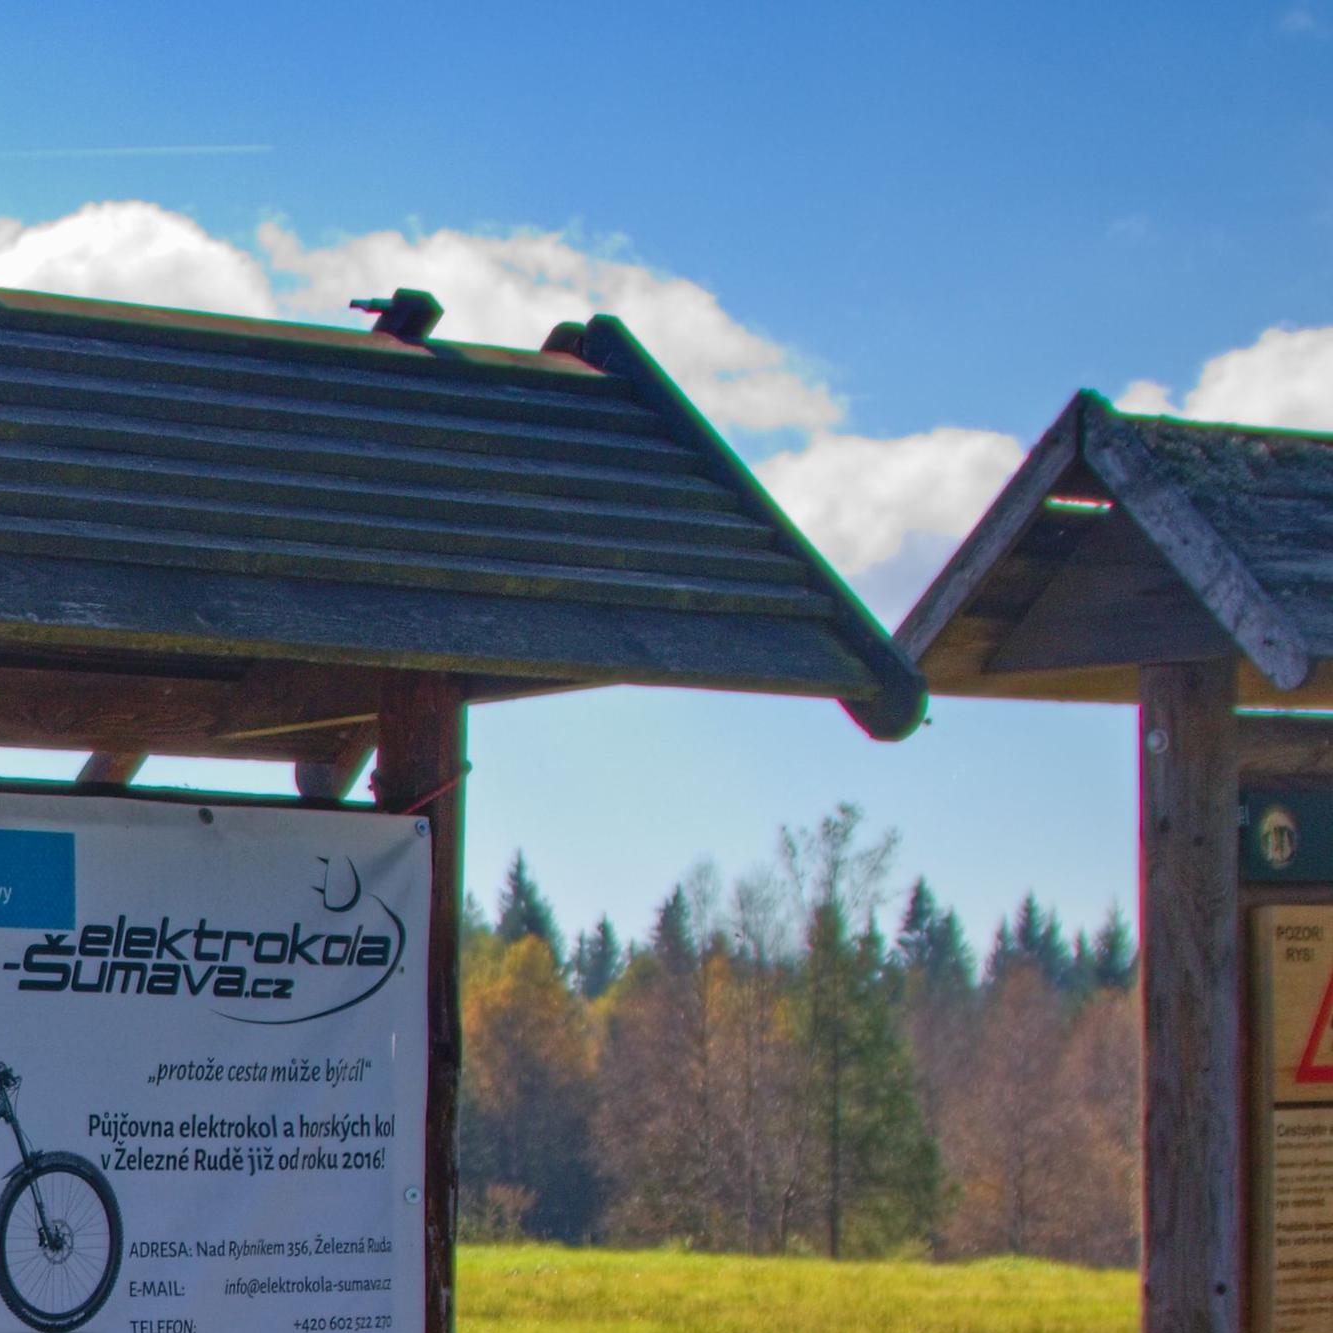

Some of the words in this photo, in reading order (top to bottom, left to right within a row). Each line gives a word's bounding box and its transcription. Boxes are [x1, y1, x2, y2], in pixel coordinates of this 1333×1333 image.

[79, 914, 392, 966] elektrokola
[228, 1061, 268, 1082] cesta
[271, 1058, 321, 1082] může
[325, 1058, 349, 1088] být
[88, 1112, 175, 1143] Půjčovna
[179, 1115, 278, 1138] elektrokol
[282, 1121, 294, 1138] a
[299, 1114, 371, 1143] horských
[375, 1114, 396, 1137] kol
[101, 1153, 111, 1170] v
[114, 1141, 189, 1171] Železné
[193, 1147, 244, 1171] Rudě
[249, 1147, 274, 1176] již
[279, 1149, 299, 1171] od
[302, 1149, 338, 1170] roku
[342, 1147, 385, 1170] 2016!
[129, 1241, 193, 1258] ADRESA:
[196, 1240, 225, 1257] Nad
[229, 1238, 285, 1260] Rybníkem
[286, 1240, 312, 1258] 356,
[314, 1234, 365, 1254] Železná
[367, 1236, 393, 1253] Ruda
[129, 1281, 185, 1297] E-MAIL:
[224, 1276, 392, 1299] info@elektrokola-sumava.cz
[293, 1317, 327, 1333] +420
[329, 1316, 355, 1331] 602
[355, 1315, 373, 1331] 522
